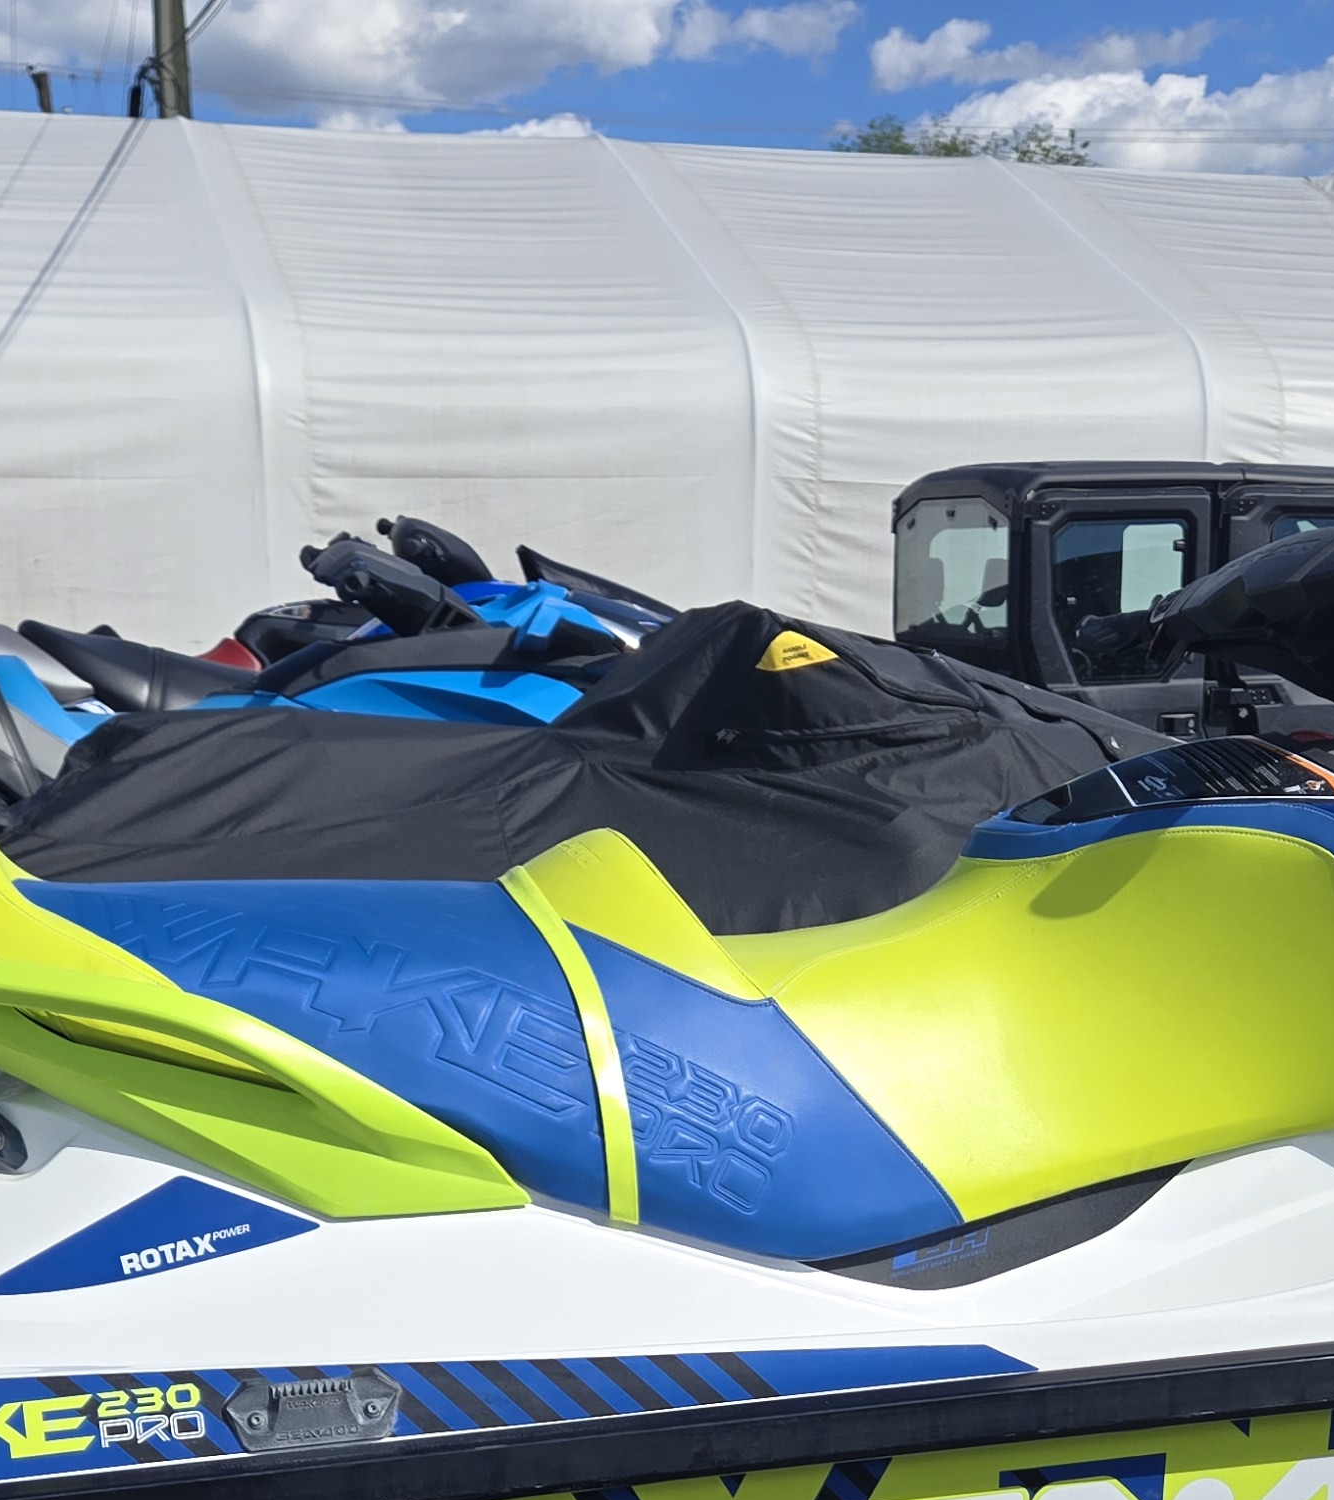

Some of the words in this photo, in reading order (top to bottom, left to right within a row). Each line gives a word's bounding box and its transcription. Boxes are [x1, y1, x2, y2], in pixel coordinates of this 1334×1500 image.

[120, 1233, 216, 1275] ROTAX
[212, 1223, 251, 1241] POWER
[97, 1383, 200, 1418] 230
[99, 1410, 205, 1449] PRO
